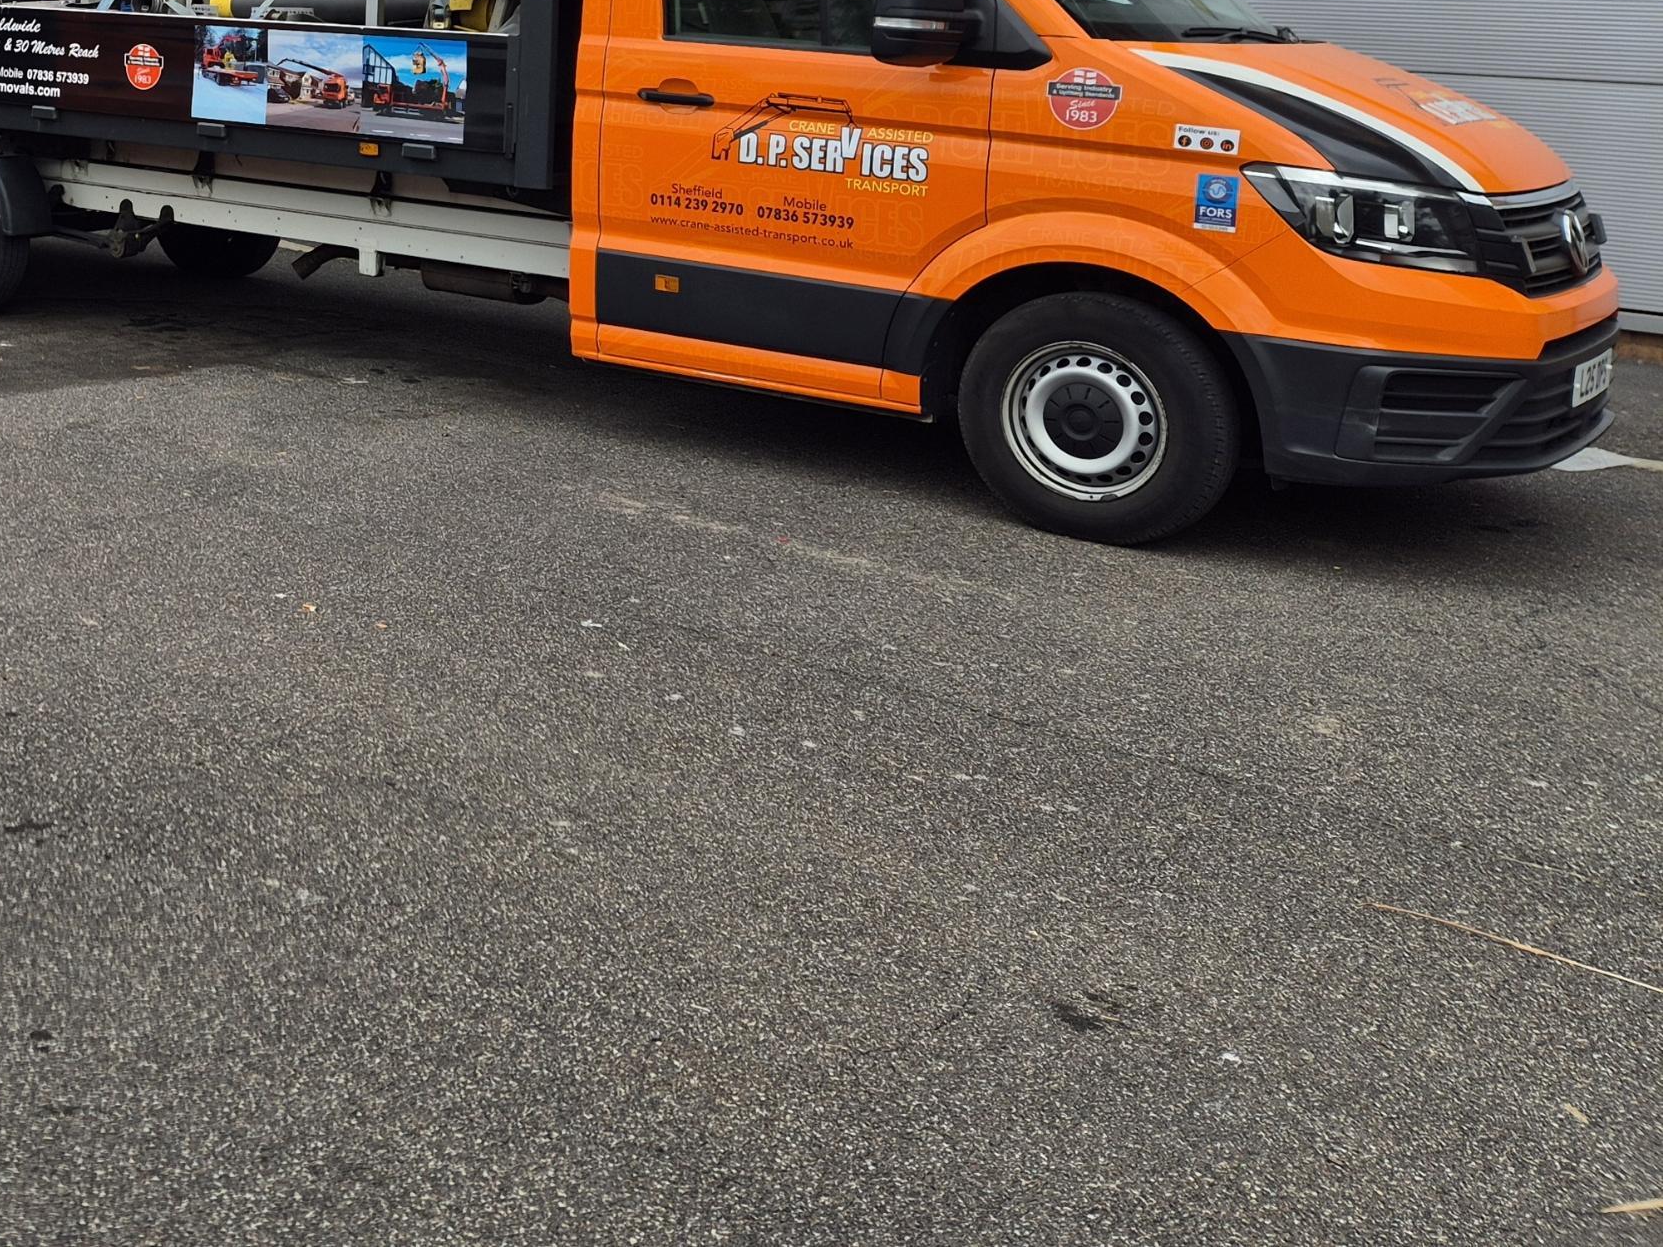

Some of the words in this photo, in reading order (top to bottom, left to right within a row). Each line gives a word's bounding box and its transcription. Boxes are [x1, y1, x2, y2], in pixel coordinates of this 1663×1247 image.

[3, 37, 12, 52] &
[14, 39, 30, 53] 30
[31, 40, 66, 56] Metres
[68, 42, 100, 59] Reach
[26, 69, 54, 82] 07836
[55, 71, 89, 85] 573939
[1065, 109, 1098, 123] 1983
[788, 119, 835, 135] CRANE
[866, 127, 935, 144] ASSISTED
[1177, 126, 1206, 135] Follow
[791, 125, 930, 183] SERVICES
[671, 183, 723, 200] Sheffield
[845, 177, 929, 197] TRANSPORT
[650, 193, 682, 209] 0114
[684, 195, 708, 212] 239
[711, 200, 744, 216] 2970
[783, 196, 827, 212] Mobile
[1199, 206, 1233, 219] FORS
[757, 205, 799, 224] 07836
[802, 211, 855, 230] 573939
[649, 215, 854, 250] www.crane-assisted-transport.co.uk
